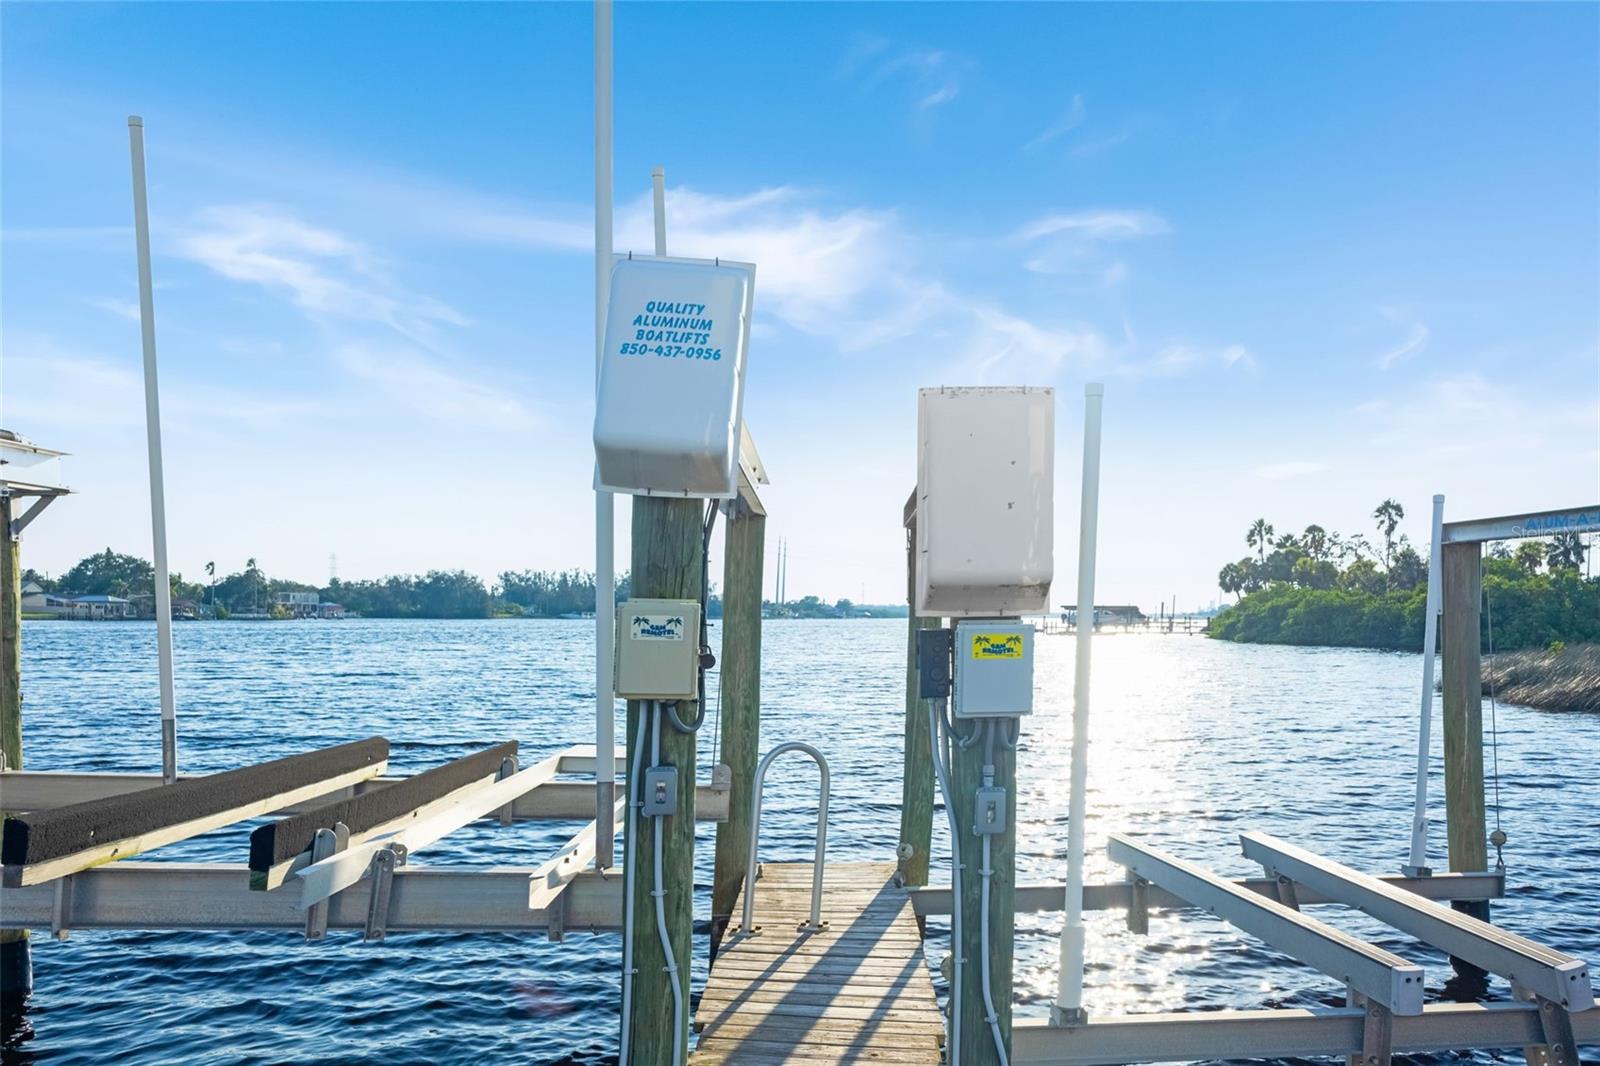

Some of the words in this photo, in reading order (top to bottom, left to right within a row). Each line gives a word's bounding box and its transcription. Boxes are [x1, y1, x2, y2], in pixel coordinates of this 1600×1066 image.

[646, 300, 706, 316] QUALITY
[633, 314, 713, 331] ALUMINUM
[635, 329, 710, 345] BOATLIFTS
[620, 343, 722, 361] 850-437-0956
